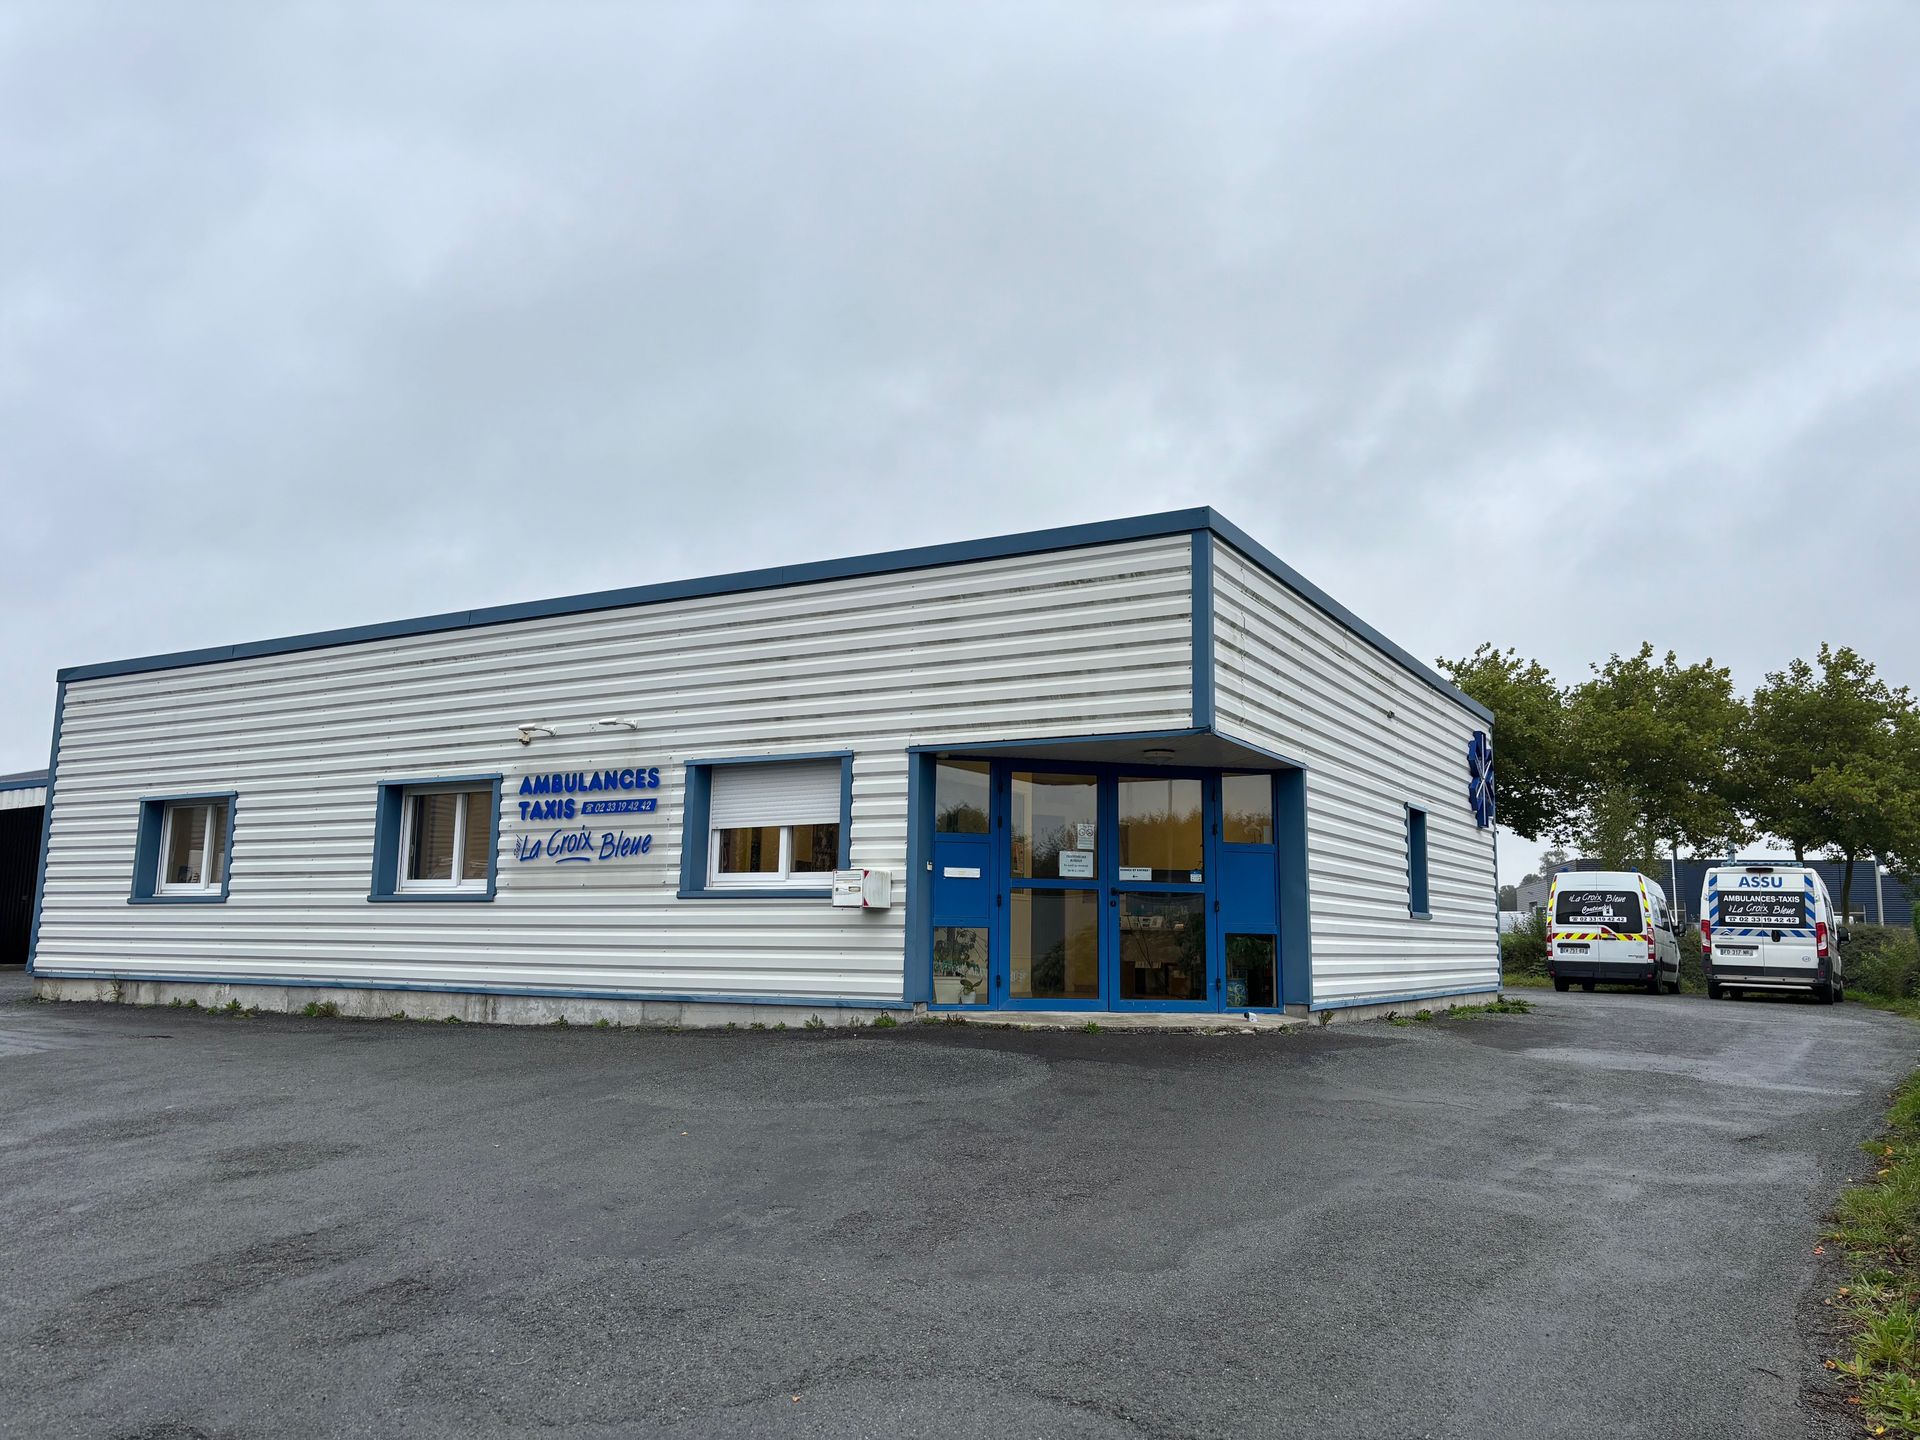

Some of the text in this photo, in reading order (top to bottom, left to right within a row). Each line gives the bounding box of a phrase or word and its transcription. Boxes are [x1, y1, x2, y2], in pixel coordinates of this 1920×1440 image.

[519, 767, 660, 795] AMBULANCES
[518, 798, 576, 821] TAXIS
[594, 800, 653, 813] 02 33 19 42 42
[519, 825, 653, 862] La Croix Bleue
[1738, 876, 1783, 888] ASSU
[1582, 893, 1602, 902] Croix
[1605, 894, 1626, 903] Bleue
[1723, 895, 1800, 903] AMBULANCES-TAXIS
[1731, 904, 1743, 913] La
[1745, 903, 1769, 913] Croix
[1772, 905, 1796, 914] Bleue
